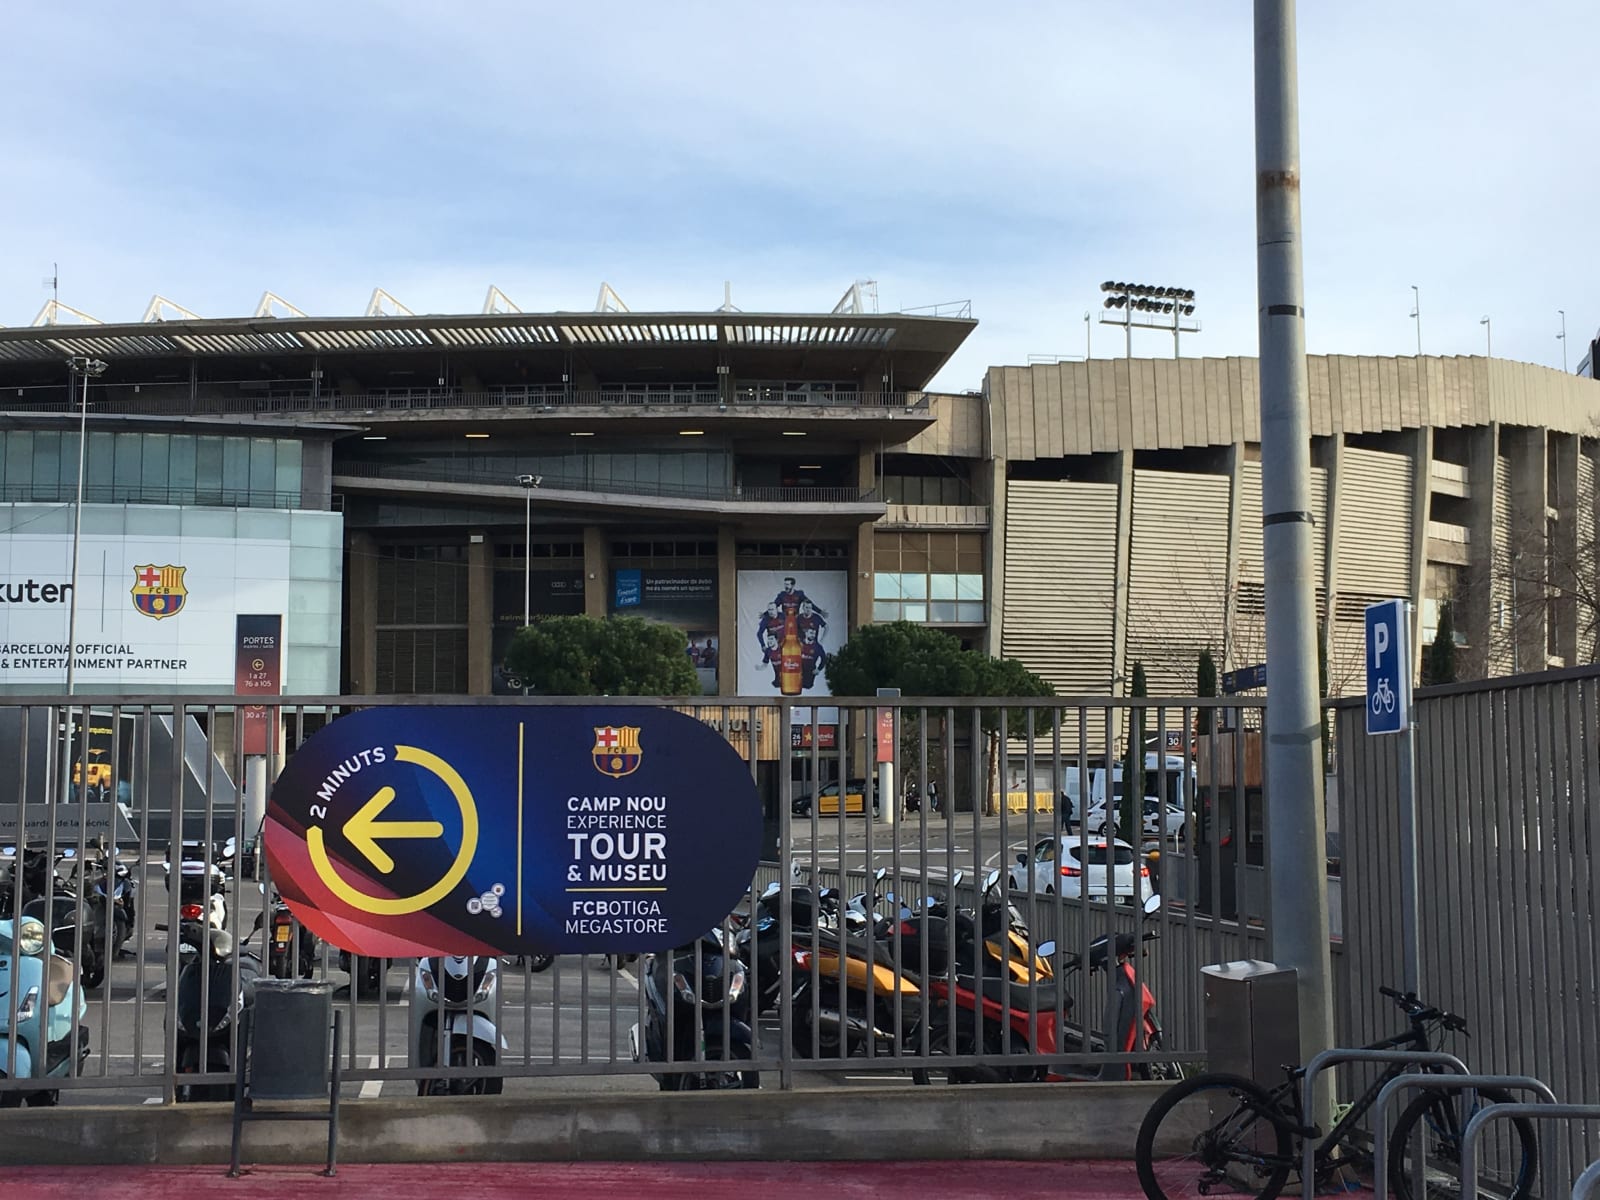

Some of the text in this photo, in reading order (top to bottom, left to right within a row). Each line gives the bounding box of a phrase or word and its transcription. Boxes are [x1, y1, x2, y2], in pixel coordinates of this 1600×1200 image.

[243, 636, 274, 644] PORTES
[1374, 622, 1389, 669] P
[75, 644, 134, 655] OFFICIAL
[1, 659, 10, 669] &
[127, 659, 187, 670] PARTNER
[1168, 738, 1179, 746] 30
[310, 746, 386, 819] 2 MINUTS
[568, 796, 666, 812] CAMP NOU
[568, 815, 666, 829] EXPERIENCE
[568, 833, 666, 860] TOUR
[567, 864, 666, 882] & MUSEU
[572, 900, 661, 916] FCBOTIGA
[565, 918, 668, 934] MEGASTORE
